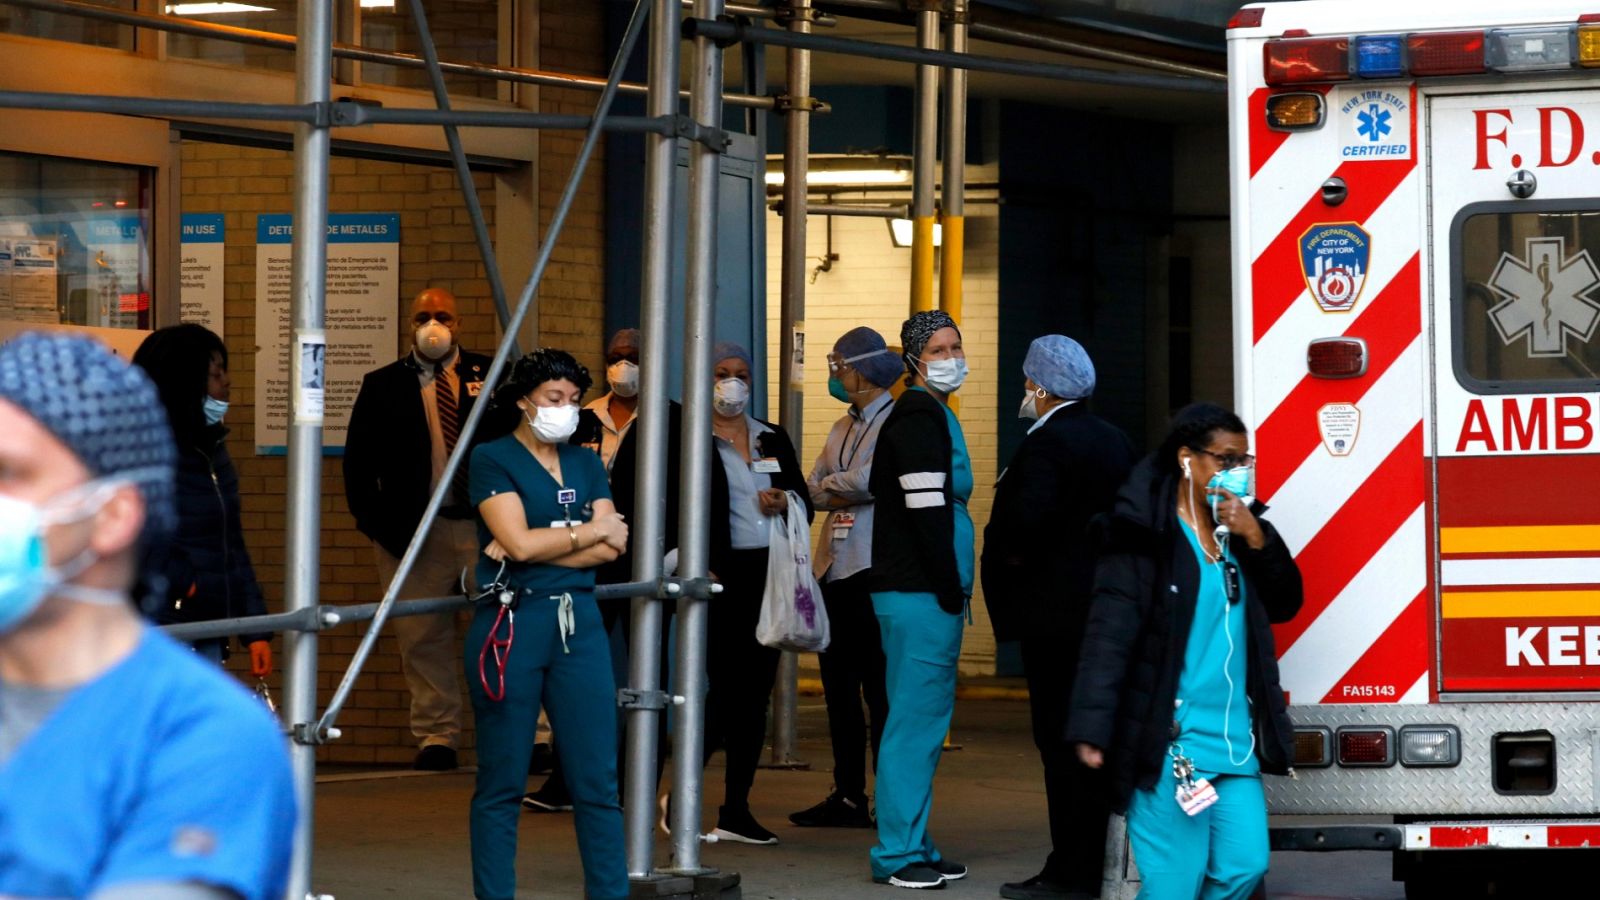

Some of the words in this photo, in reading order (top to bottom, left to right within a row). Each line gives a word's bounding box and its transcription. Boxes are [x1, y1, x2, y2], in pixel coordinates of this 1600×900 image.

[1341, 95, 1361, 115] NEW
[1360, 90, 1383, 103] YORK
[1383, 93, 1408, 113] STATE
[1342, 145, 1407, 157] CERTIFIED
[183, 225, 194, 234] IN
[195, 225, 216, 234] USE
[340, 225, 388, 234] METALES
[1307, 235, 1321, 250] FIRE
[1320, 229, 1364, 247] DEPARTMENT
[1342, 685, 1396, 697] FA15143
